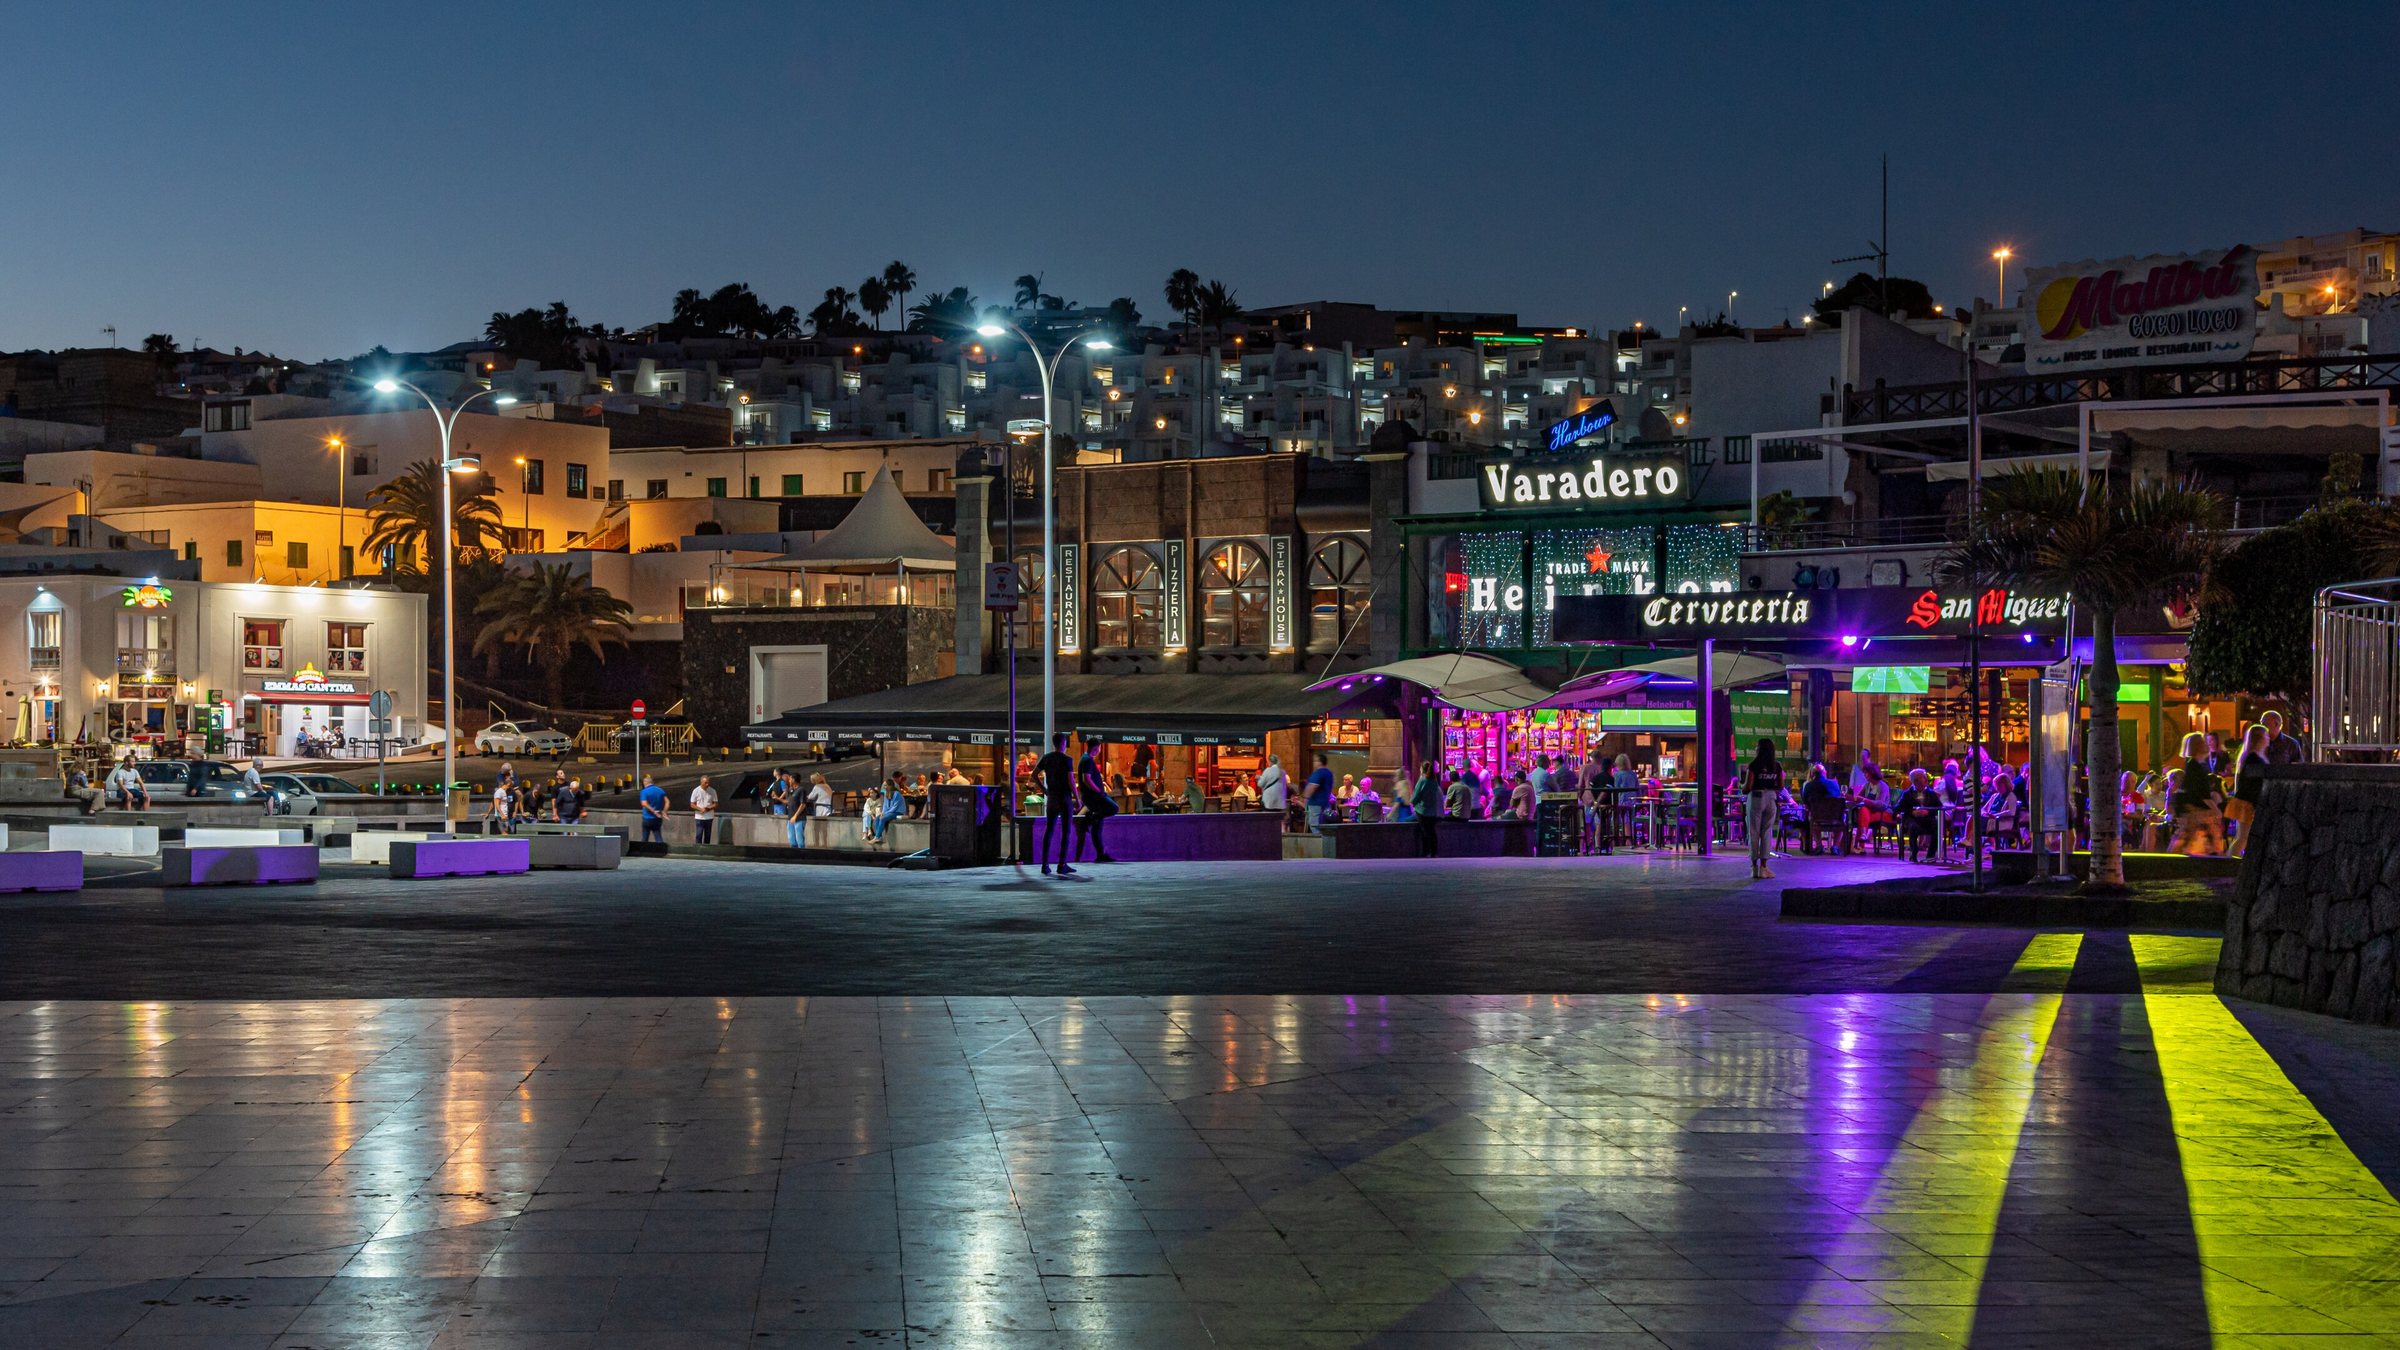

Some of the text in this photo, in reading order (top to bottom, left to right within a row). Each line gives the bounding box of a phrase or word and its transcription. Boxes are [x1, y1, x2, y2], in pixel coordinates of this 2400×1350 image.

[2042, 244, 2247, 340] Malibú
[2129, 308, 2239, 338] COCO LOCO
[2063, 341, 2212, 362] MUSIC LOUNGE RESTAURANT
[1550, 413, 1612, 450] Harbour
[1484, 459, 1679, 503] Varadero
[1548, 560, 1649, 575] TRADE MARK
[1065, 549, 1073, 643] RESTAURANTE
[1171, 545, 1179, 642] PIZZERIA
[1276, 542, 1286, 640] STEAK HOUSE
[1644, 592, 1809, 627] Cervecería
[1906, 590, 1970, 629] San
[264, 681, 355, 693] EMMAS CANTINA
